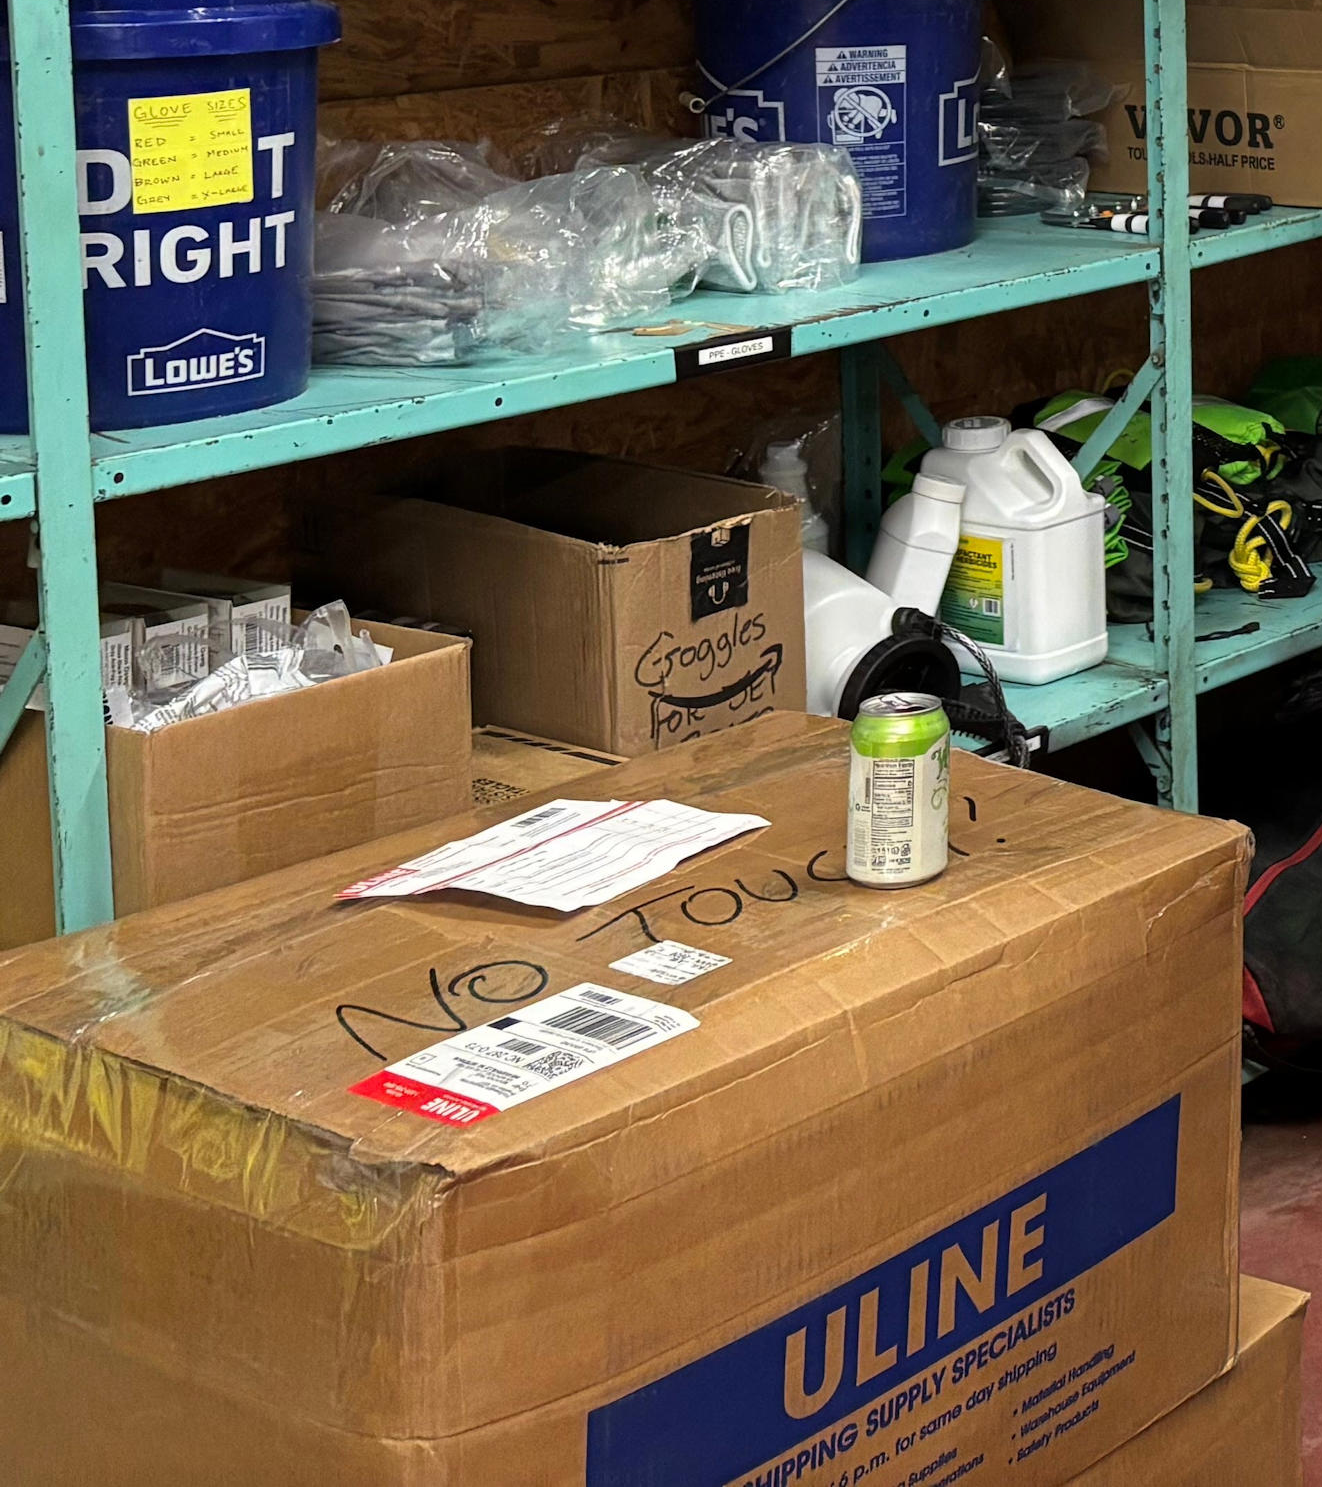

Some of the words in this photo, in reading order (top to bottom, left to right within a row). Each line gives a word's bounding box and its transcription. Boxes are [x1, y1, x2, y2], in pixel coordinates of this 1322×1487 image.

[839, 60, 897, 71] ADVERTENCIA
[849, 48, 889, 59] WARNING
[834, 72, 901, 84] AVERTISSEMENT
[133, 103, 193, 120] GLOVE
[207, 96, 248, 111] SIZES
[134, 137, 167, 149] RED
[210, 128, 245, 140] SMALL
[132, 155, 178, 168] GREEN
[206, 145, 249, 159] MEDIUM
[1240, 155, 1276, 170] PRICE
[134, 174, 181, 187] BROWN
[203, 165, 239, 180] LARGE
[136, 194, 171, 206] GREY
[201, 184, 249, 201] X-LARGE
[81, 210, 296, 290] RIGHT
[708, 349, 725, 360] PPE
[731, 342, 764, 356] GLOVES
[144, 346, 256, 388] LOWE'S
[335, 959, 550, 1062] NO
[422, 1098, 481, 1124] ULINE
[783, 1193, 1048, 1420] ULINE
[866, 1364, 948, 1438] SUPPLY
[952, 1288, 1076, 1386] SPECIALISTS
[1020, 1370, 1067, 1415] Material
[1067, 1343, 1115, 1383] Handling
[1018, 1390, 1080, 1439] Warehouse
[1080, 1350, 1136, 1398] Equipment
[853, 1451, 891, 1486] p.m.
[895, 1431, 917, 1456] for
[919, 1402, 963, 1442] same
[965, 1381, 995, 1416] day
[996, 1342, 1058, 1392] shipping
[1015, 1428, 1053, 1464] Safety
[1053, 1397, 1100, 1445] Products
